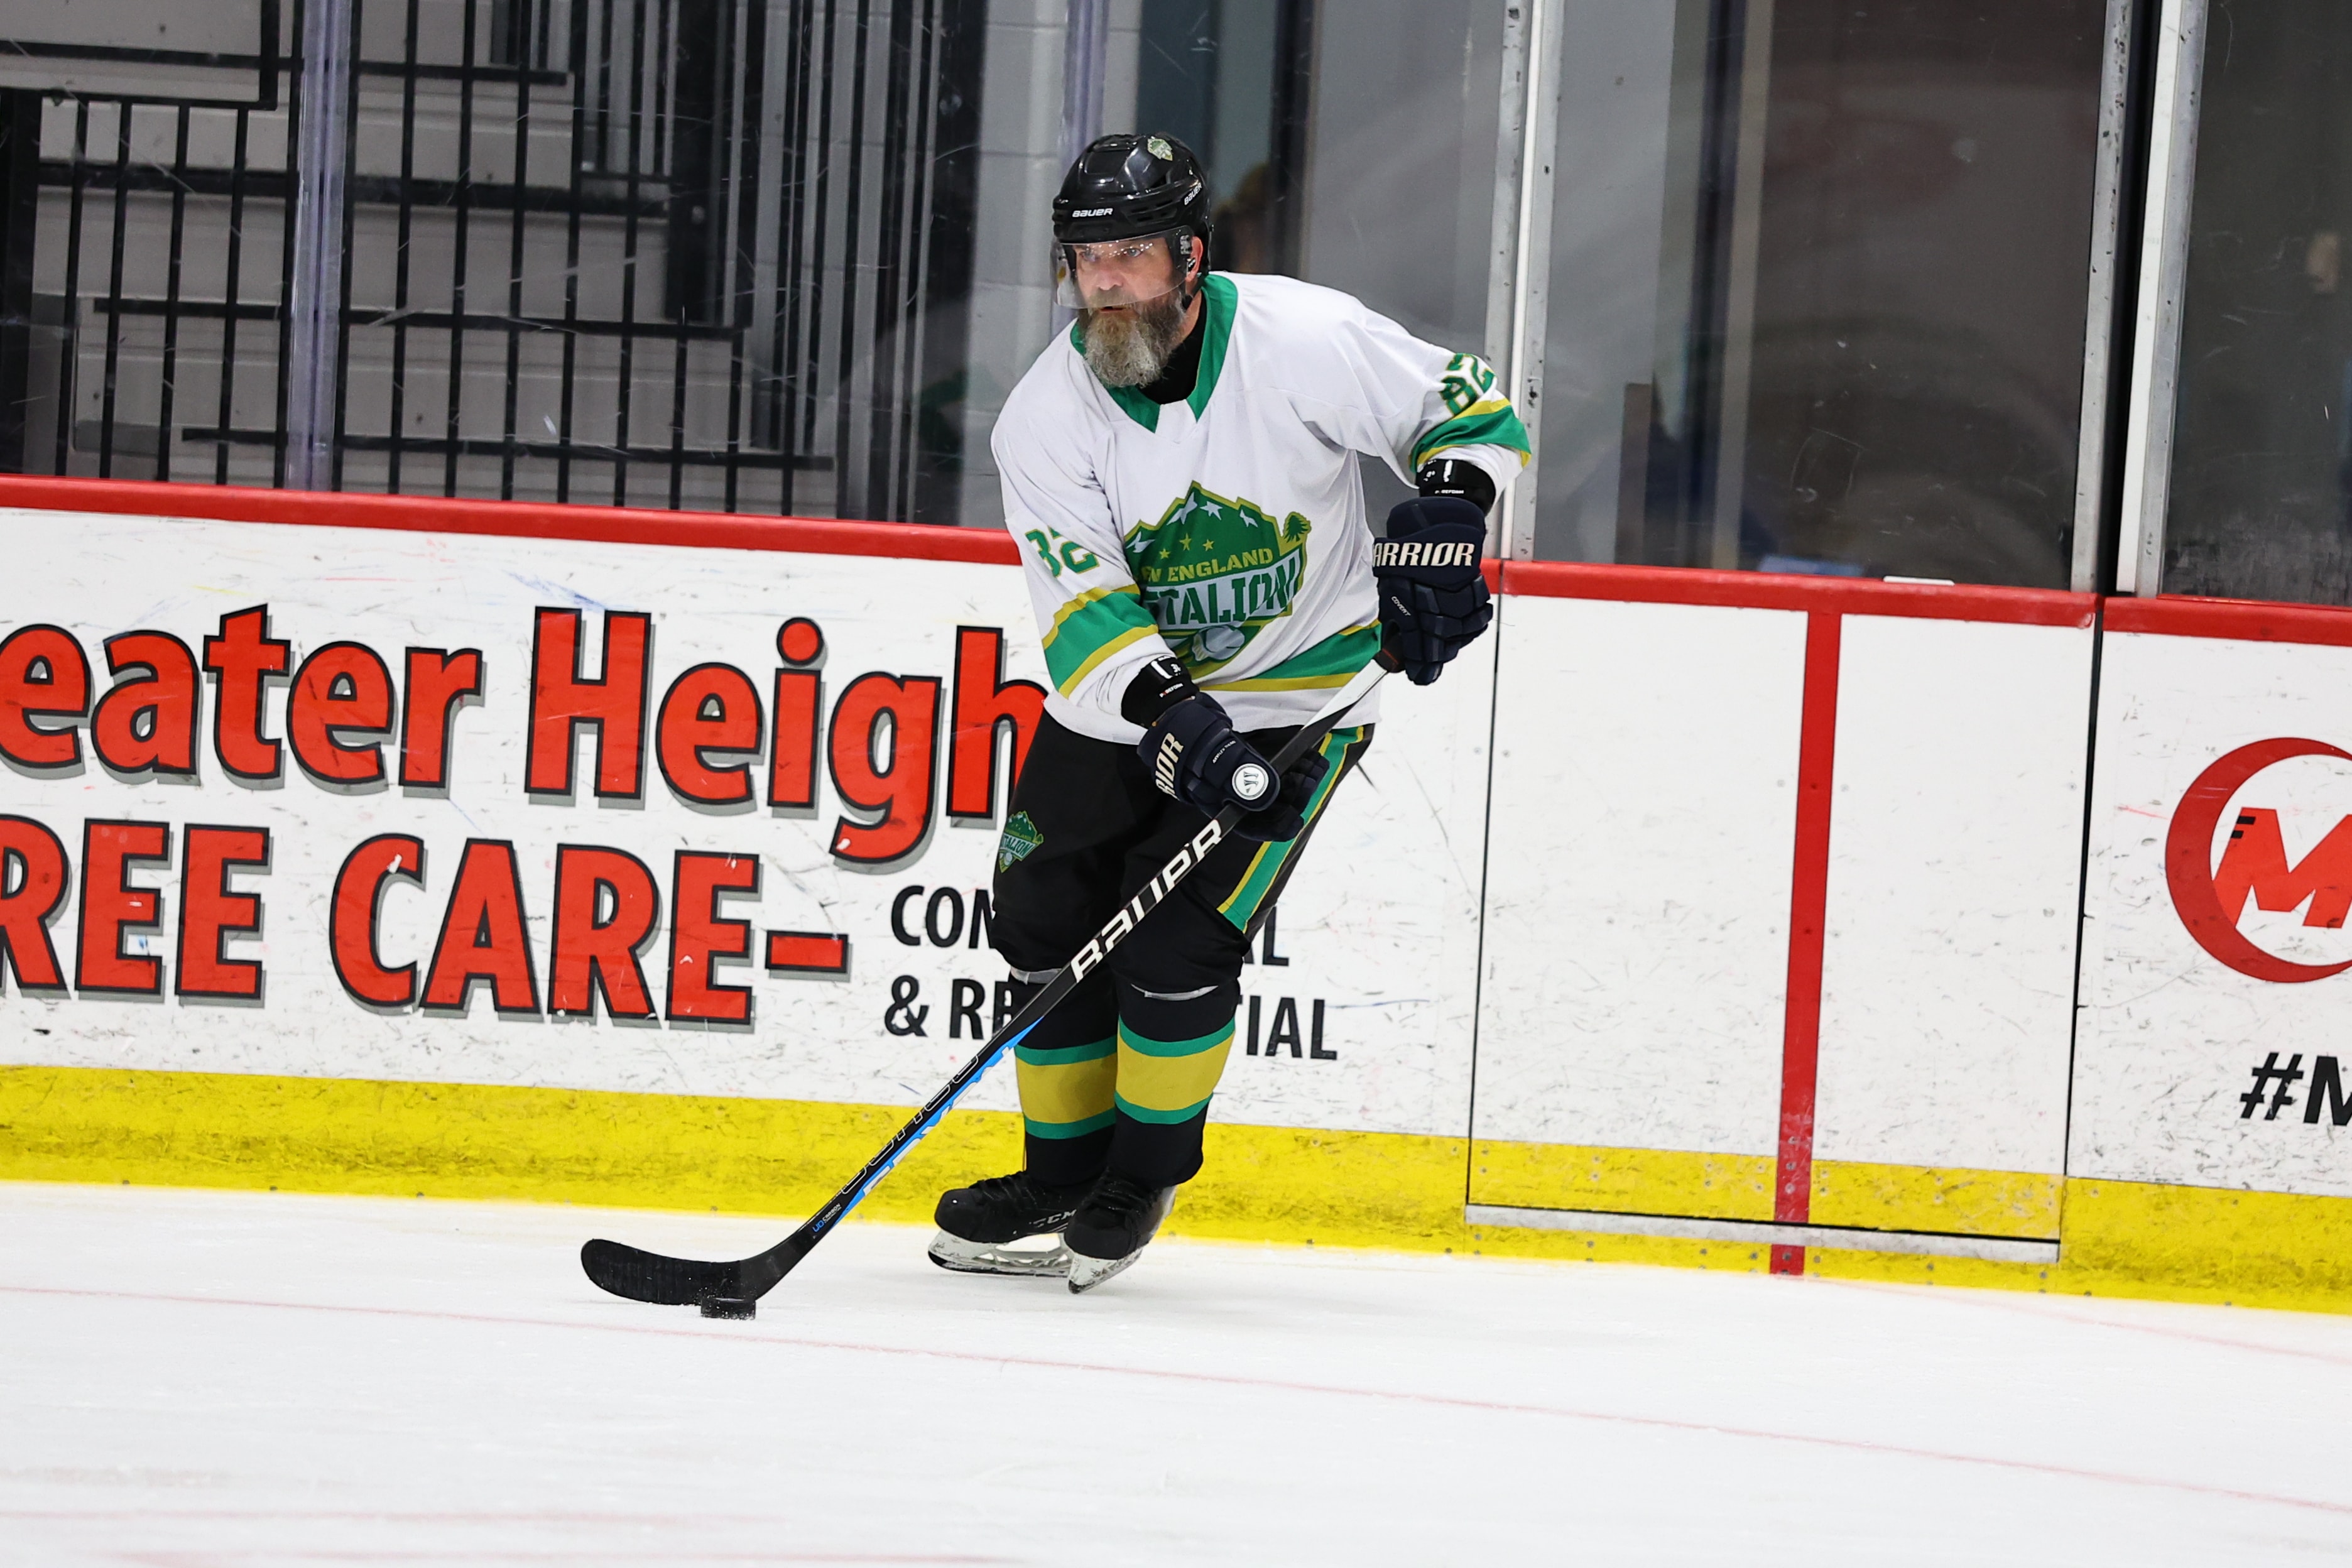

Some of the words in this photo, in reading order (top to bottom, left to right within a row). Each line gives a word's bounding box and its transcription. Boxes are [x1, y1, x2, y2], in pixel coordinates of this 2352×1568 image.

[1184, 183, 1202, 205] BAUER
[1072, 208, 1113, 217] BAUER
[1167, 548, 1273, 582] ENGLAND
[1373, 542, 1475, 567] ARRIOR
[1391, 596, 1412, 617] COVERT
[884, 974, 930, 1037] &
